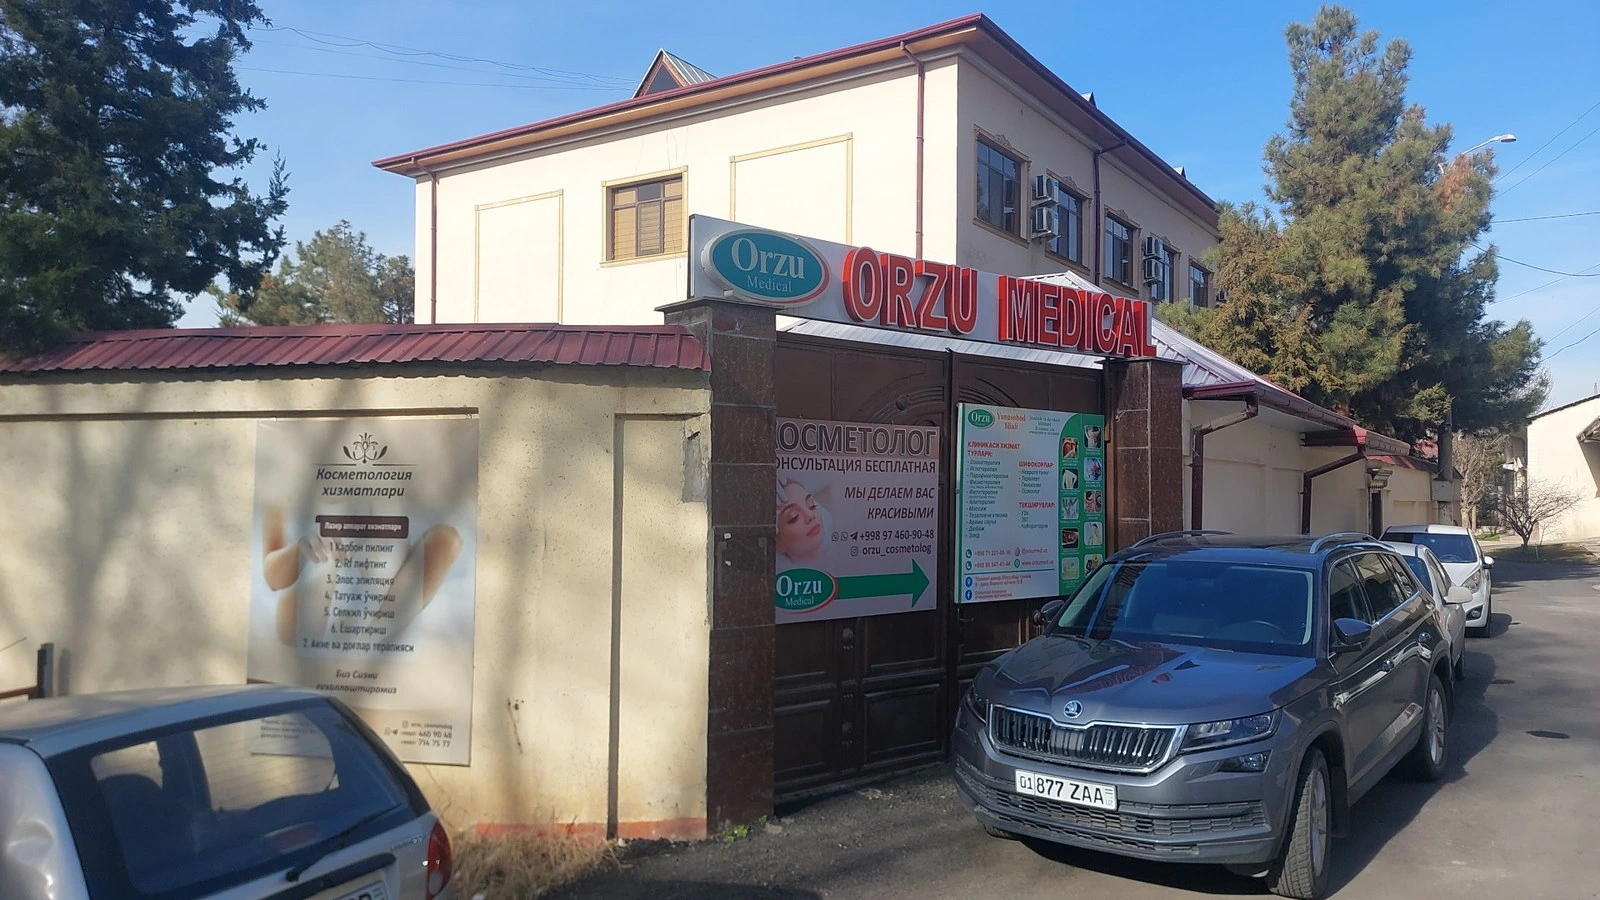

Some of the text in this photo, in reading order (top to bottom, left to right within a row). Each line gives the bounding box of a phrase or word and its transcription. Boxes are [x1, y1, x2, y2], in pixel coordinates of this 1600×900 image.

[731, 238, 804, 279] Orzu
[747, 275, 792, 292] Medical
[843, 247, 1157, 357] ORZU MEDICAL
[971, 412, 990, 423] Orzu
[776, 422, 937, 456] ОСМЕТОЛОГ
[865, 460, 936, 473] БЕСПЛАТНАЯ
[316, 468, 412, 482] Косметология
[322, 485, 405, 499] хизматлари
[845, 487, 935, 501] МЫ ДЕЛАЕМ ВАС
[867, 507, 934, 520] КРАСИВЫМИ
[860, 529, 935, 541] +998 97 460-90-48
[336, 541, 364, 553] Карбон
[365, 545, 394, 553] пилинг
[862, 543, 932, 557] orzu_cosmetolog
[353, 557, 388, 570] лифтинг
[776, 575, 822, 597] Orzu
[334, 591, 362, 603] Татуаж
[785, 596, 815, 607] Medical
[1020, 775, 1104, 805] 01 877 ZAA
